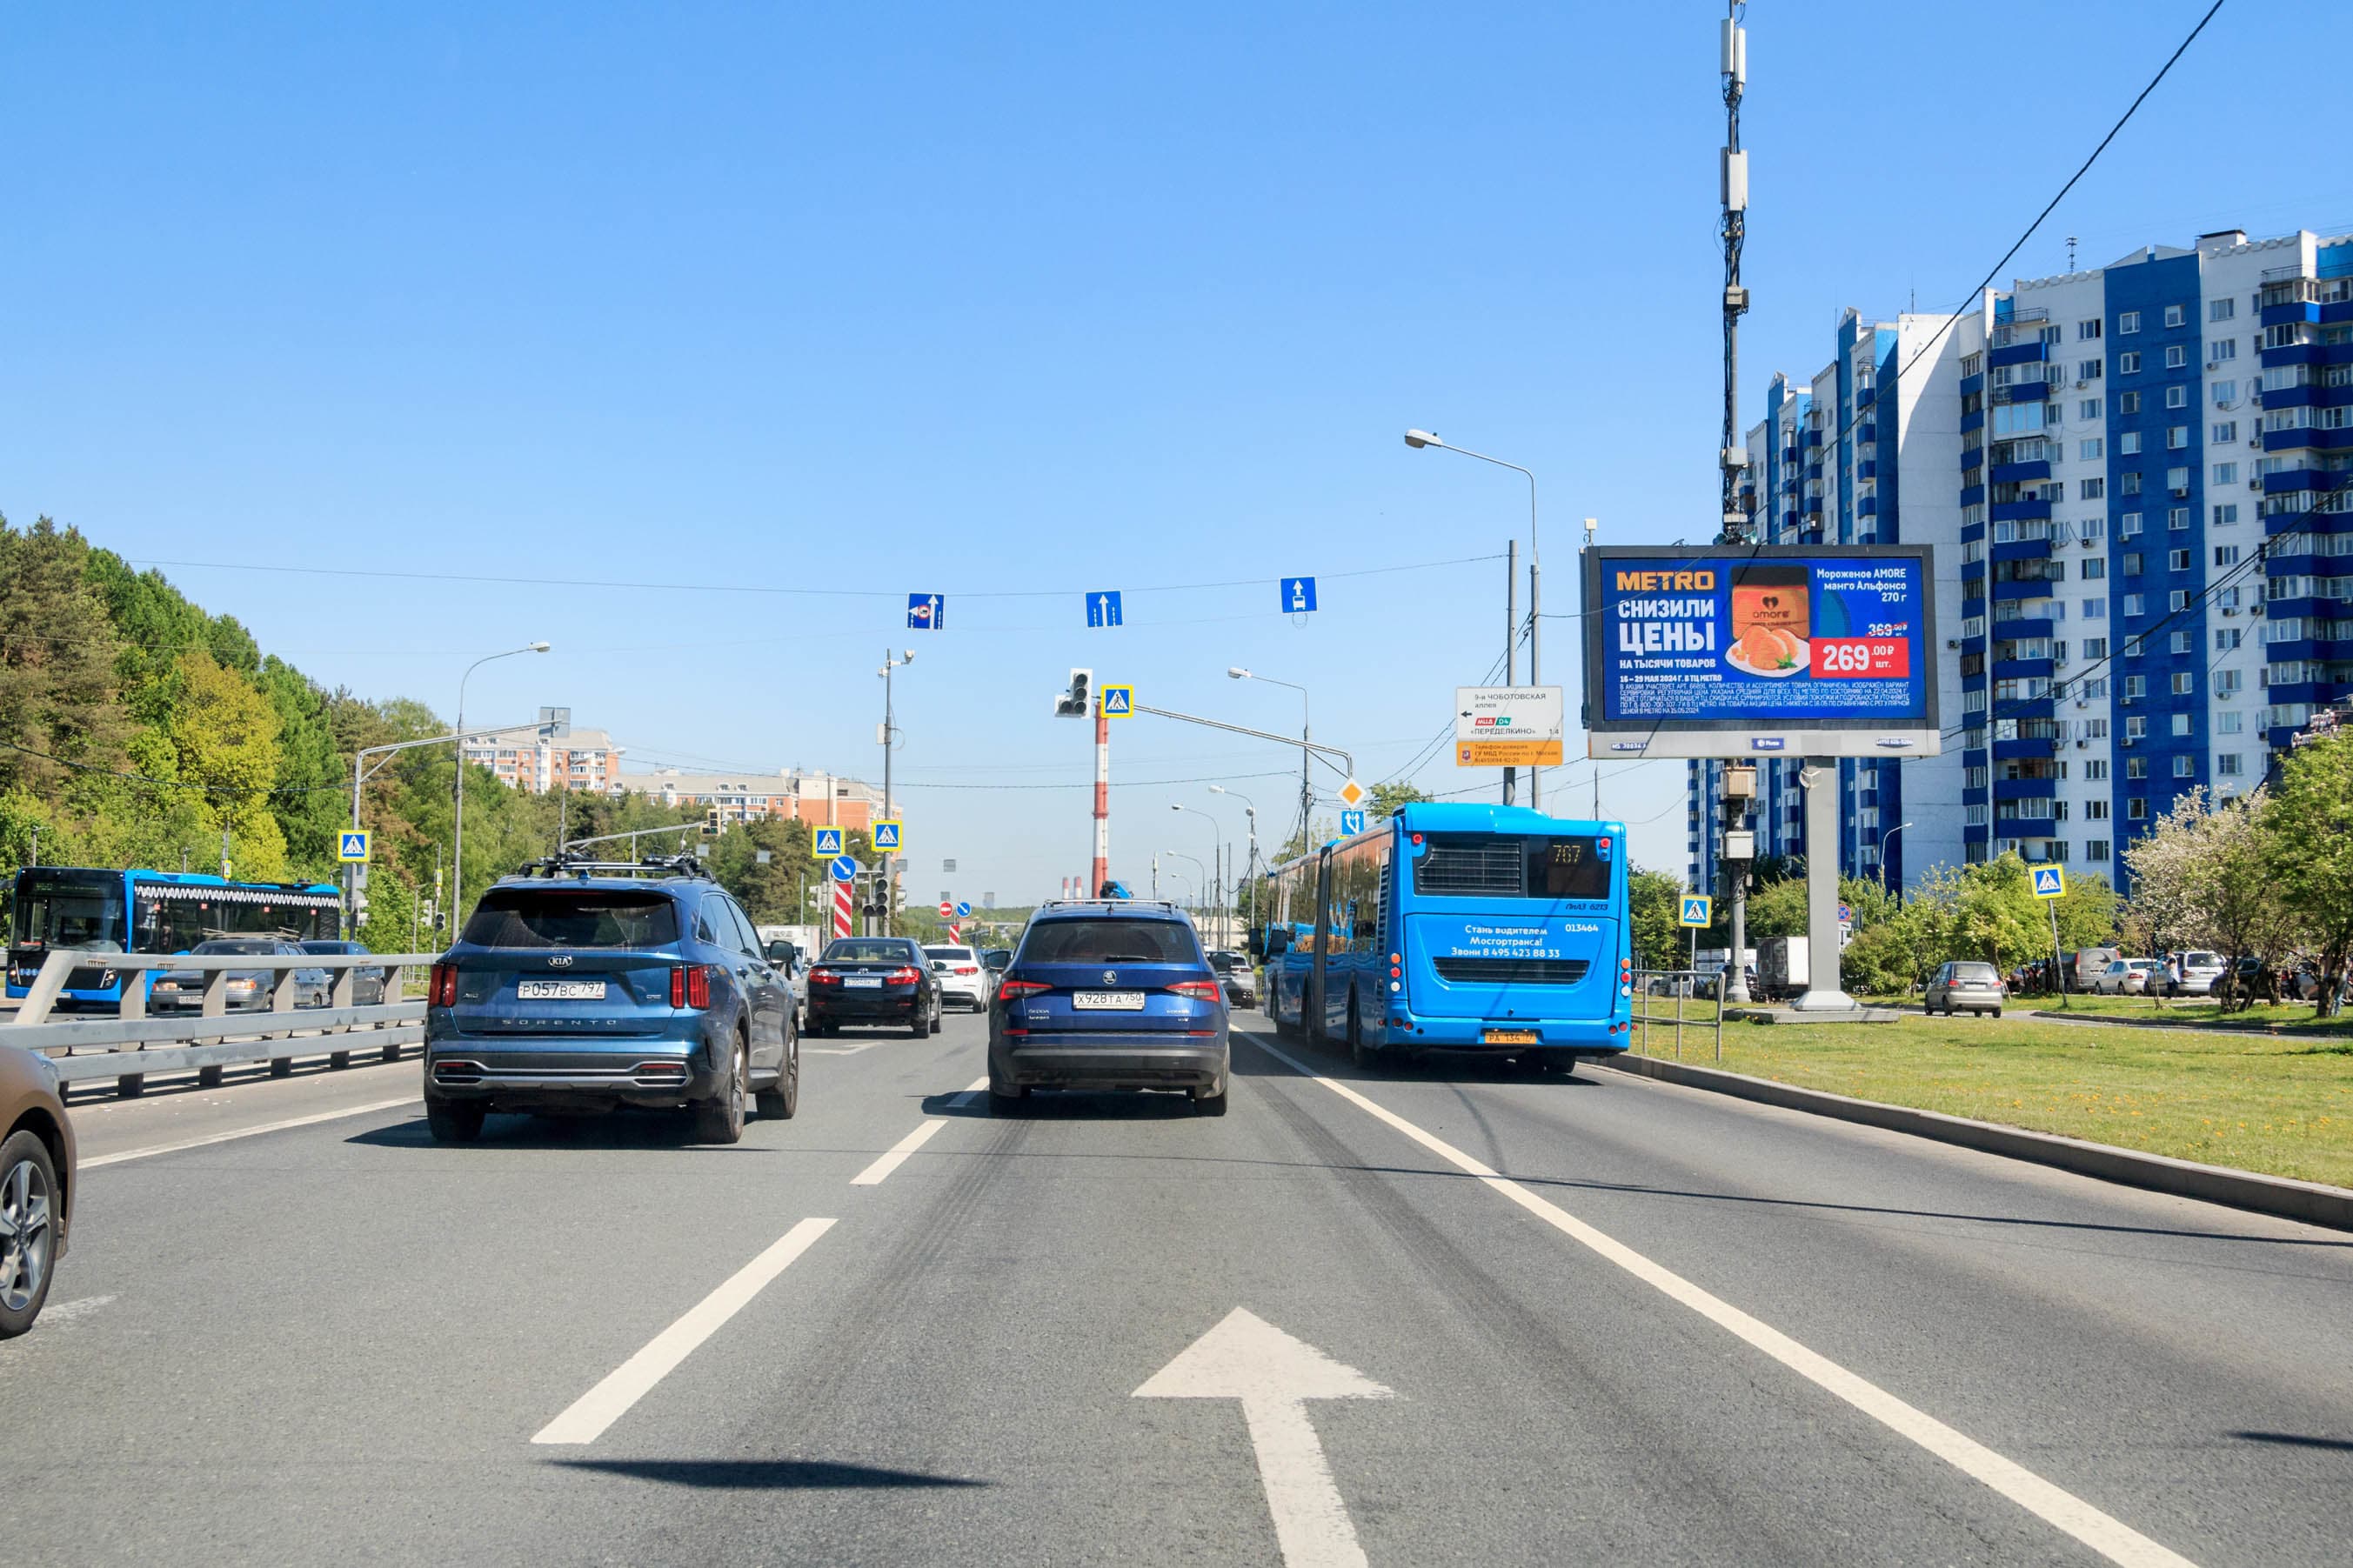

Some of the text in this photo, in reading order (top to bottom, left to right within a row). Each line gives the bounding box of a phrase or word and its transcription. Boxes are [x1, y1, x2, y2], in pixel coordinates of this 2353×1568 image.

[1816, 568, 1907, 580] Мороженое AMORE
[1616, 570, 1715, 591] METRO
[1823, 580, 1907, 592] манго Альфонсо
[1881, 592, 1899, 602] 270
[1618, 598, 1715, 618] СНИЗИЛИ
[1619, 622, 1715, 657] ЦЕНЫ
[1619, 658, 1716, 669] НА ТЫСЯЧИ ТОВАРОВ
[1822, 644, 1870, 671] 269
[1552, 844, 1581, 863] 767
[1465, 924, 1548, 936] Стань водителем
[1565, 924, 1599, 932] 013464
[1469, 937, 1543, 946] Мосгортранса!
[1451, 947, 1481, 956] Звони
[1482, 947, 1489, 956] 8
[1491, 948, 1510, 957] 495
[1512, 948, 1531, 957] 423
[1548, 949, 1561, 957] 33
[551, 957, 569, 966] KIA
[581, 982, 602, 993] 797
